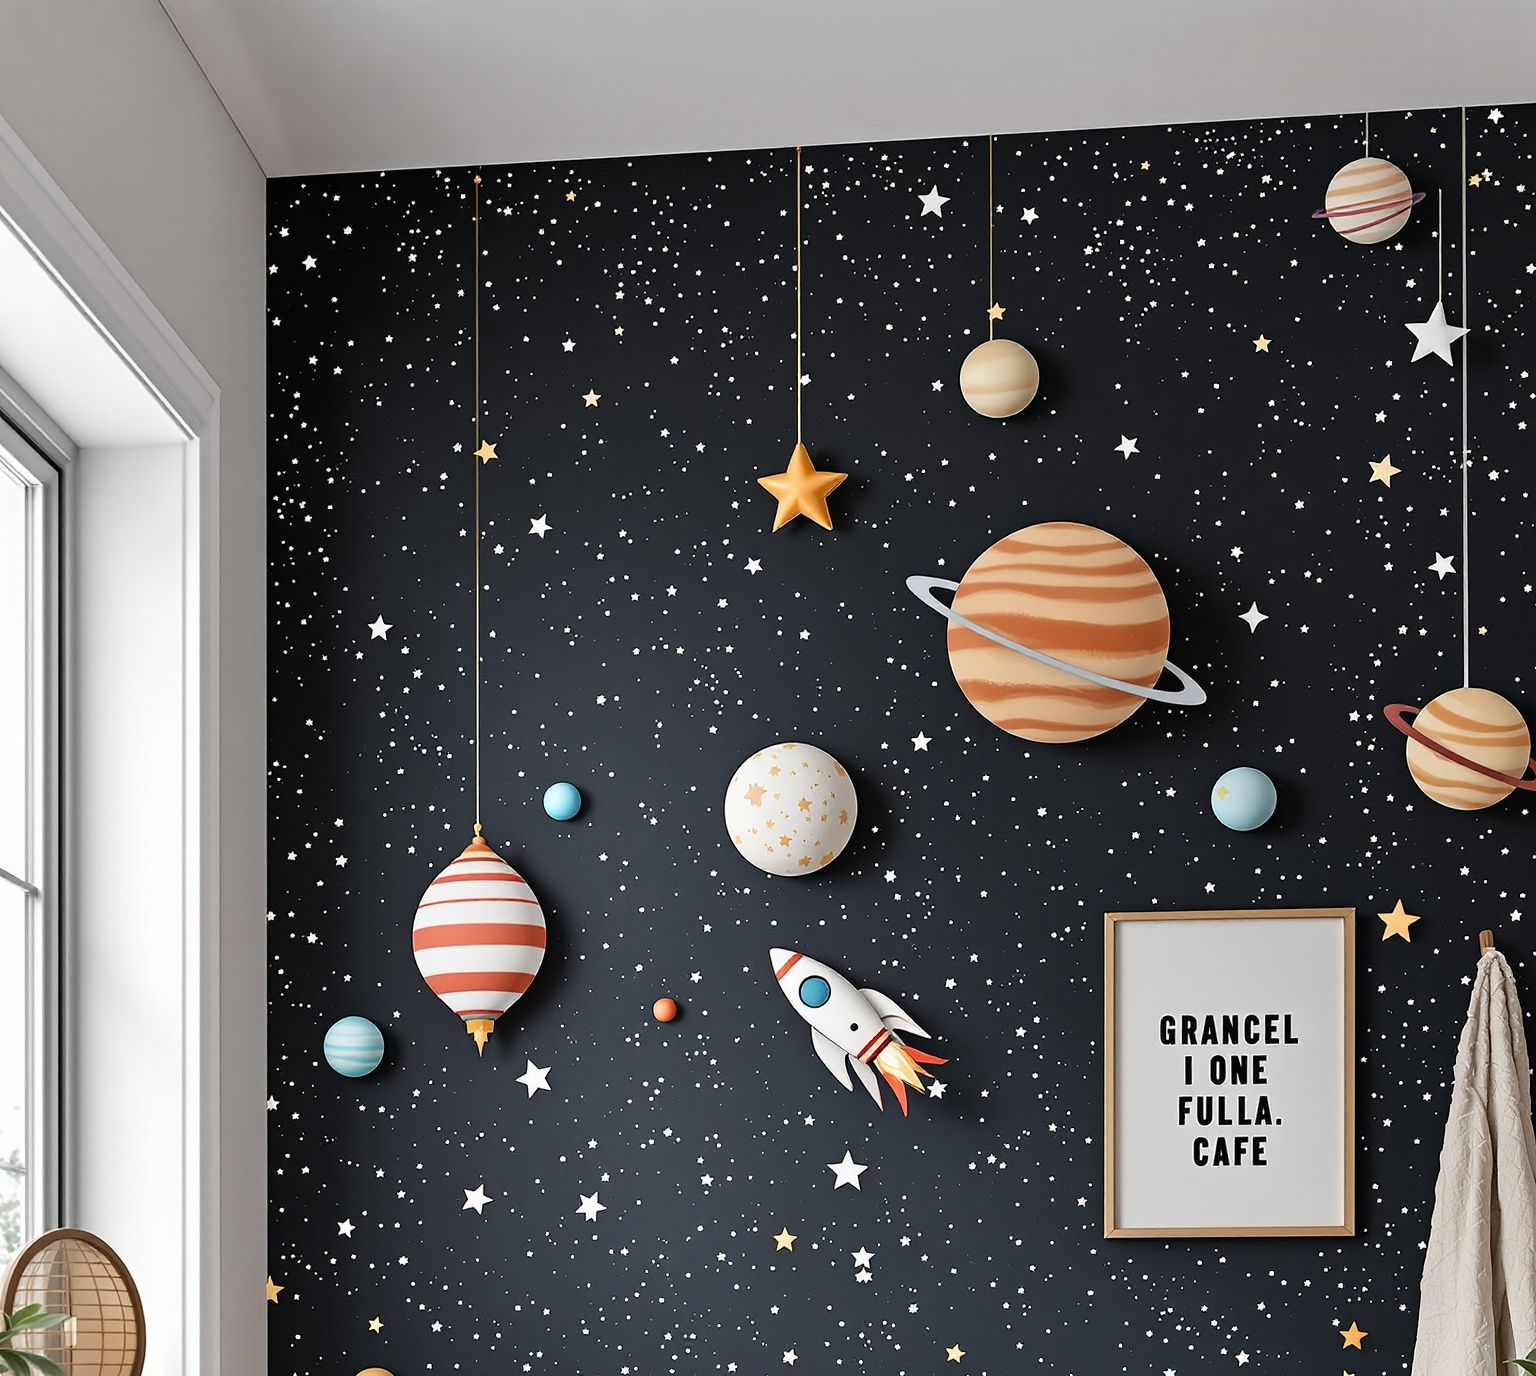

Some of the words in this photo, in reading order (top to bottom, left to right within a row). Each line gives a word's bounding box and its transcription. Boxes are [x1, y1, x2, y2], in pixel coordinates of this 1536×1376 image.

[1159, 1014, 1299, 1046] GRANCEL
[1184, 1055, 1193, 1086] I
[1210, 1055, 1268, 1086] ONE
[1178, 1095, 1282, 1126] FULLA.
[1193, 1136, 1268, 1167] CAFE
